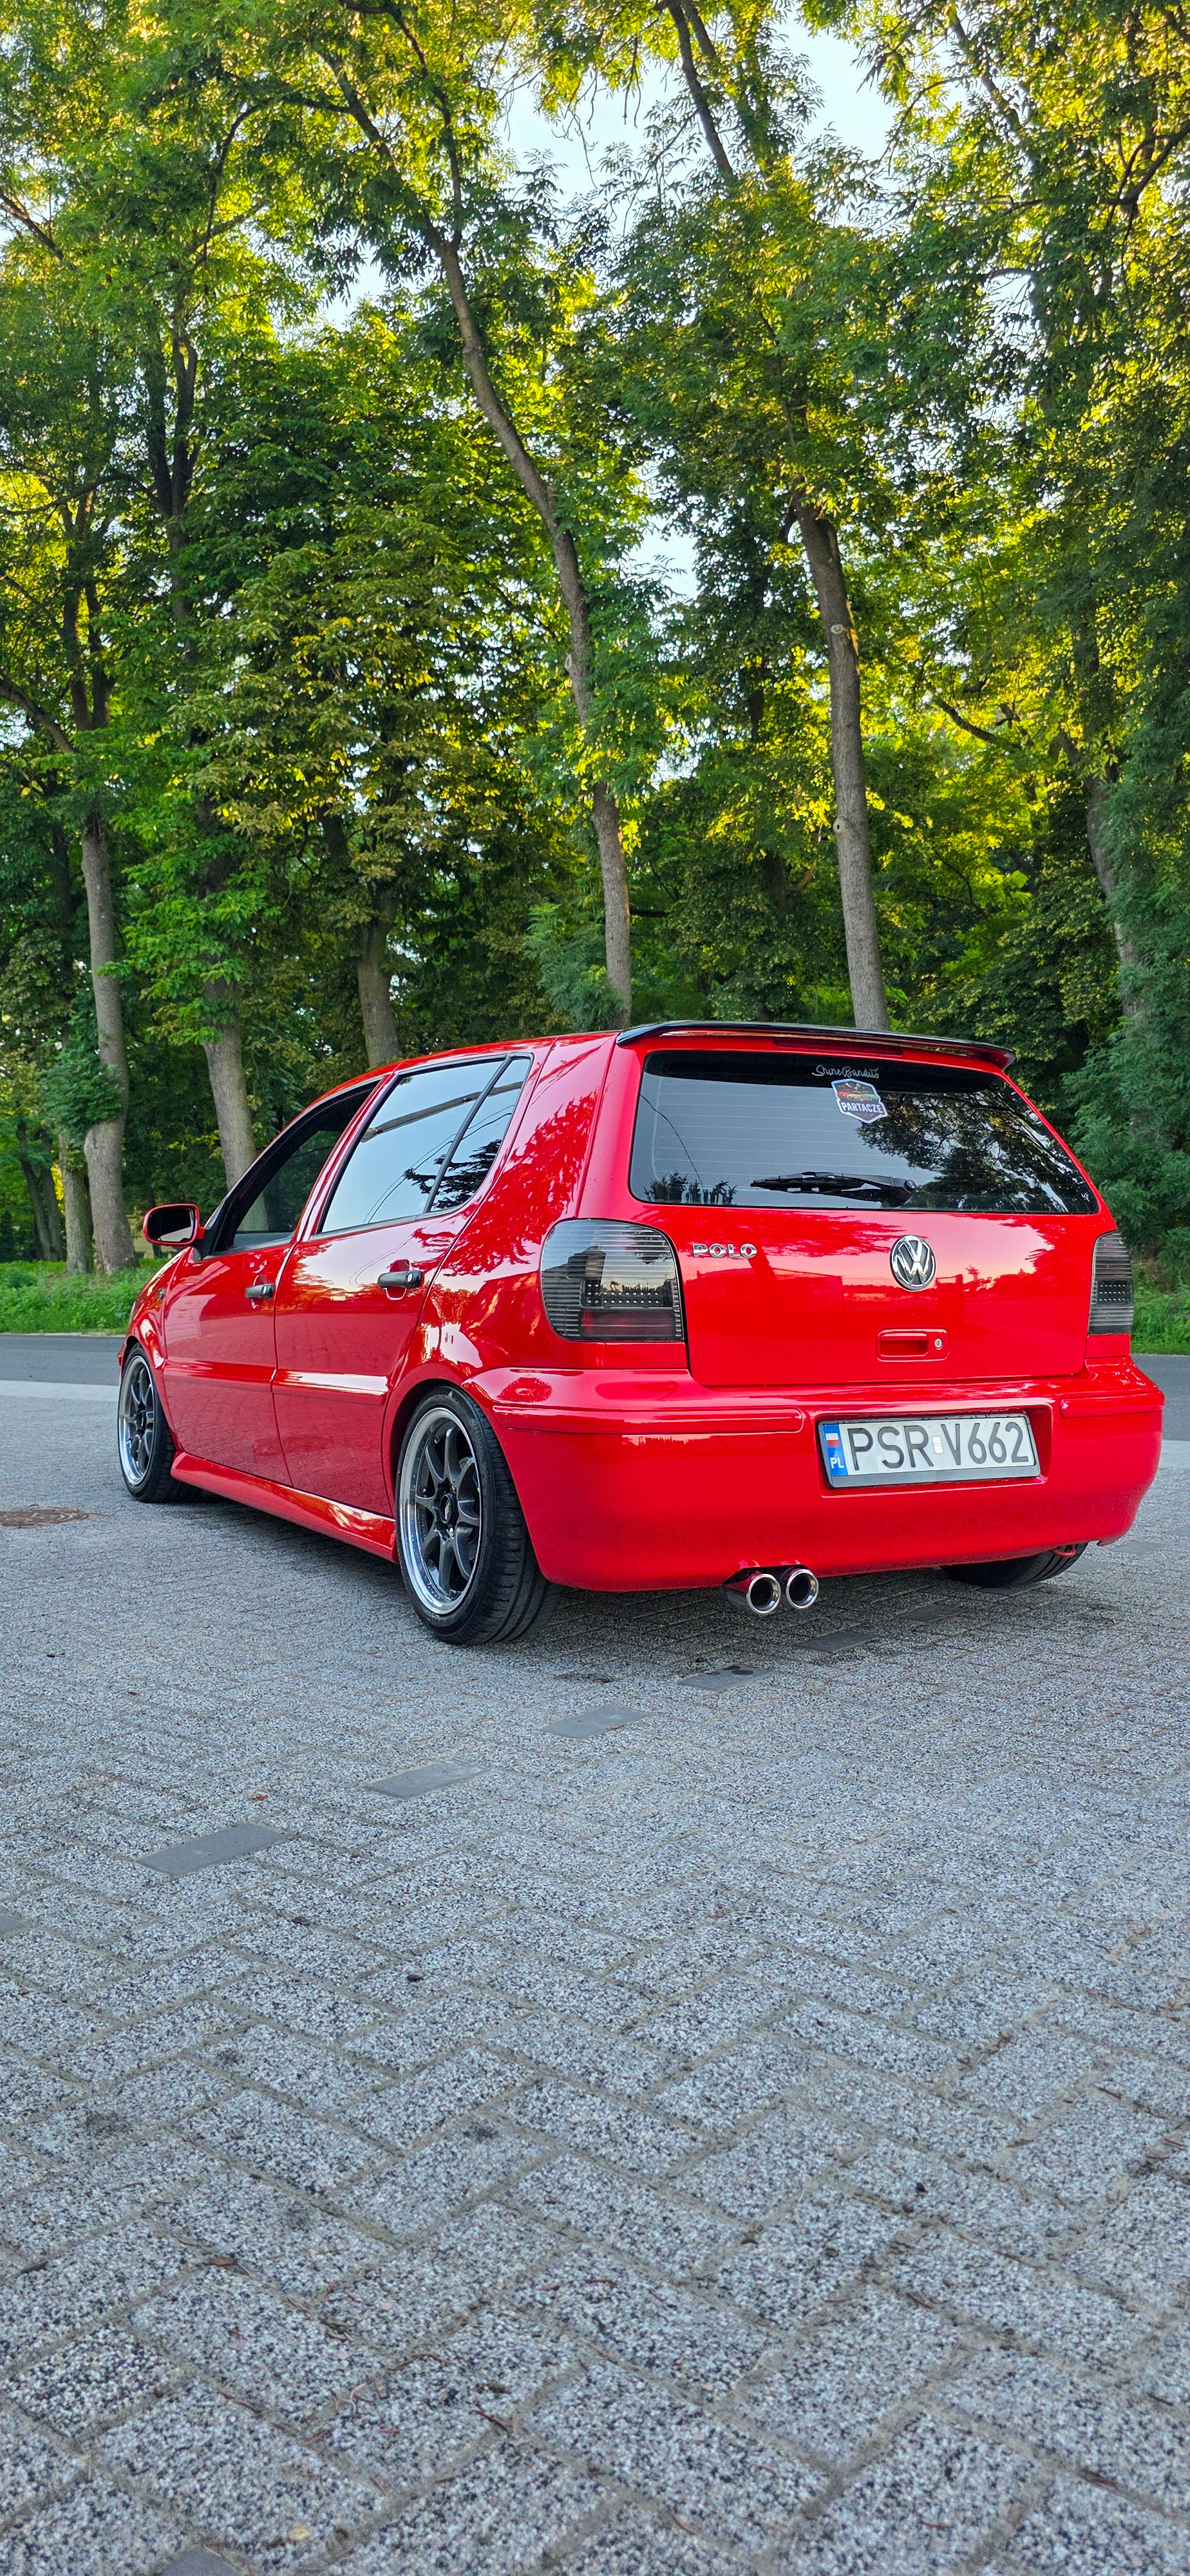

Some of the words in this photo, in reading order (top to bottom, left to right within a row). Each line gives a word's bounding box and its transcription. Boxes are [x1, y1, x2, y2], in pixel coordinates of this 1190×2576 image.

[841, 1103, 883, 1113] PARTACZE
[693, 1244, 757, 1258] POLO
[847, 1425, 934, 1470] PSR
[941, 1422, 1029, 1466] V662
[830, 1457, 844, 1468] PL
